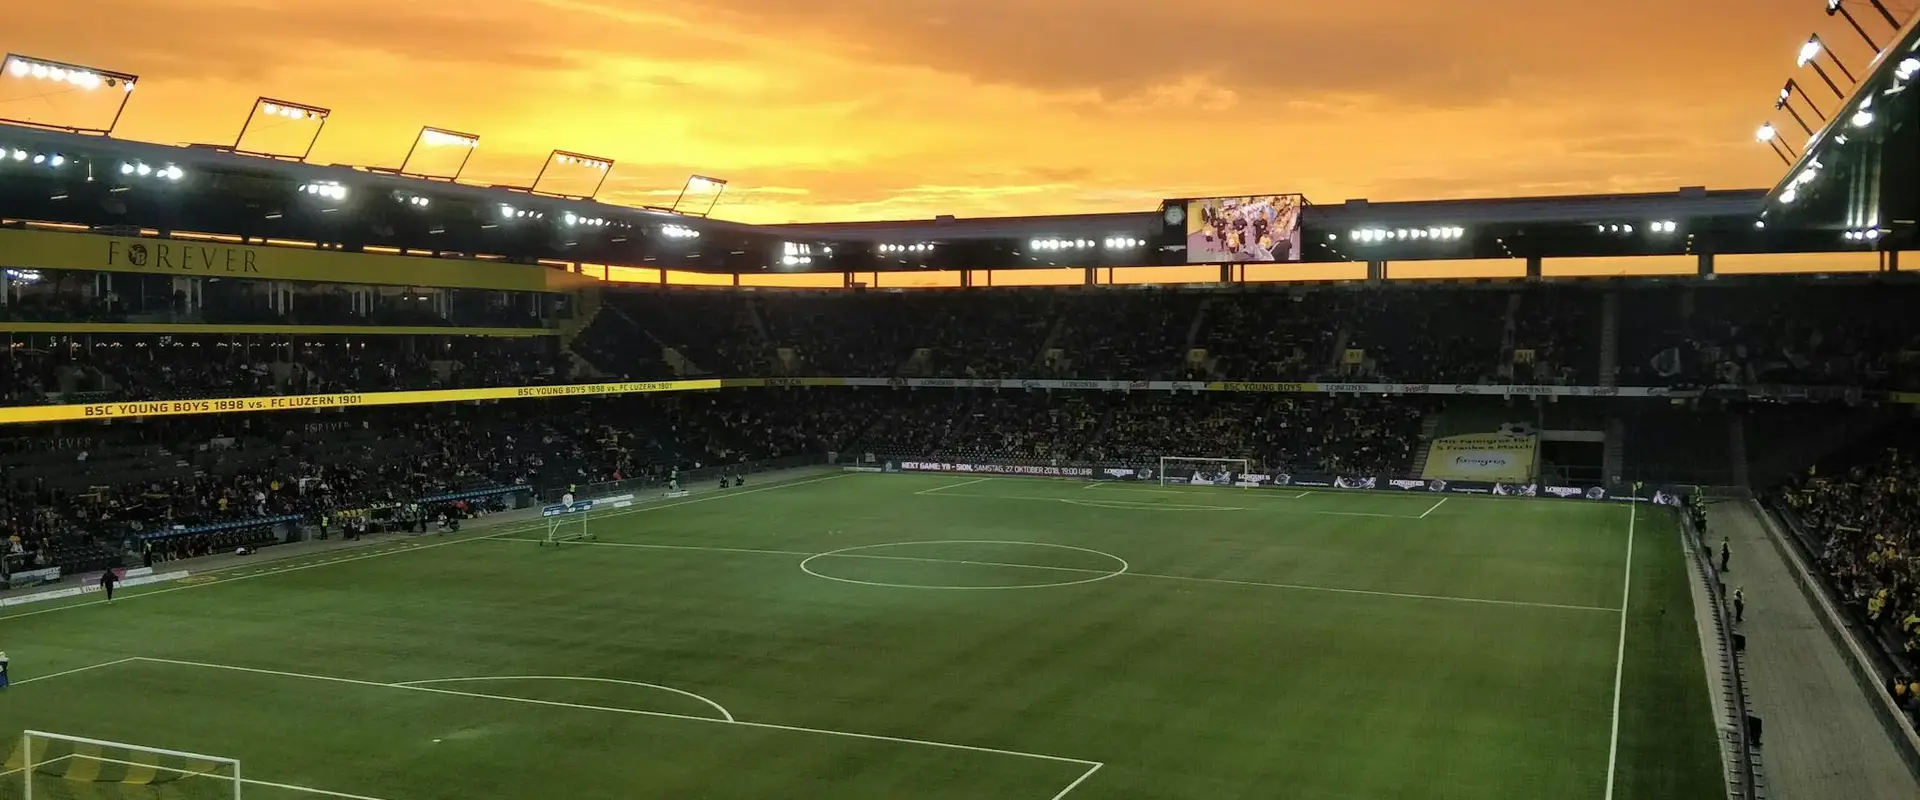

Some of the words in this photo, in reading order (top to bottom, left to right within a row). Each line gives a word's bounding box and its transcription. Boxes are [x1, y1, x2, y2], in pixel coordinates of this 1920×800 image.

[517, 388, 534, 396] BSC
[537, 386, 564, 395] YOUNG
[566, 385, 586, 394] BOYS
[589, 385, 605, 393] 1898
[631, 382, 656, 390] LUZERN
[659, 381, 673, 389] 1901
[85, 405, 113, 416] BSC
[119, 402, 168, 414] YOUNG
[175, 401, 209, 412] BOYS
[215, 400, 243, 410] 1898
[248, 401, 266, 409] vs.
[271, 399, 285, 408] FC
[289, 397, 334, 407] LUZERN
[339, 395, 362, 405] 1901
[920, 462, 941, 470] GAME:
